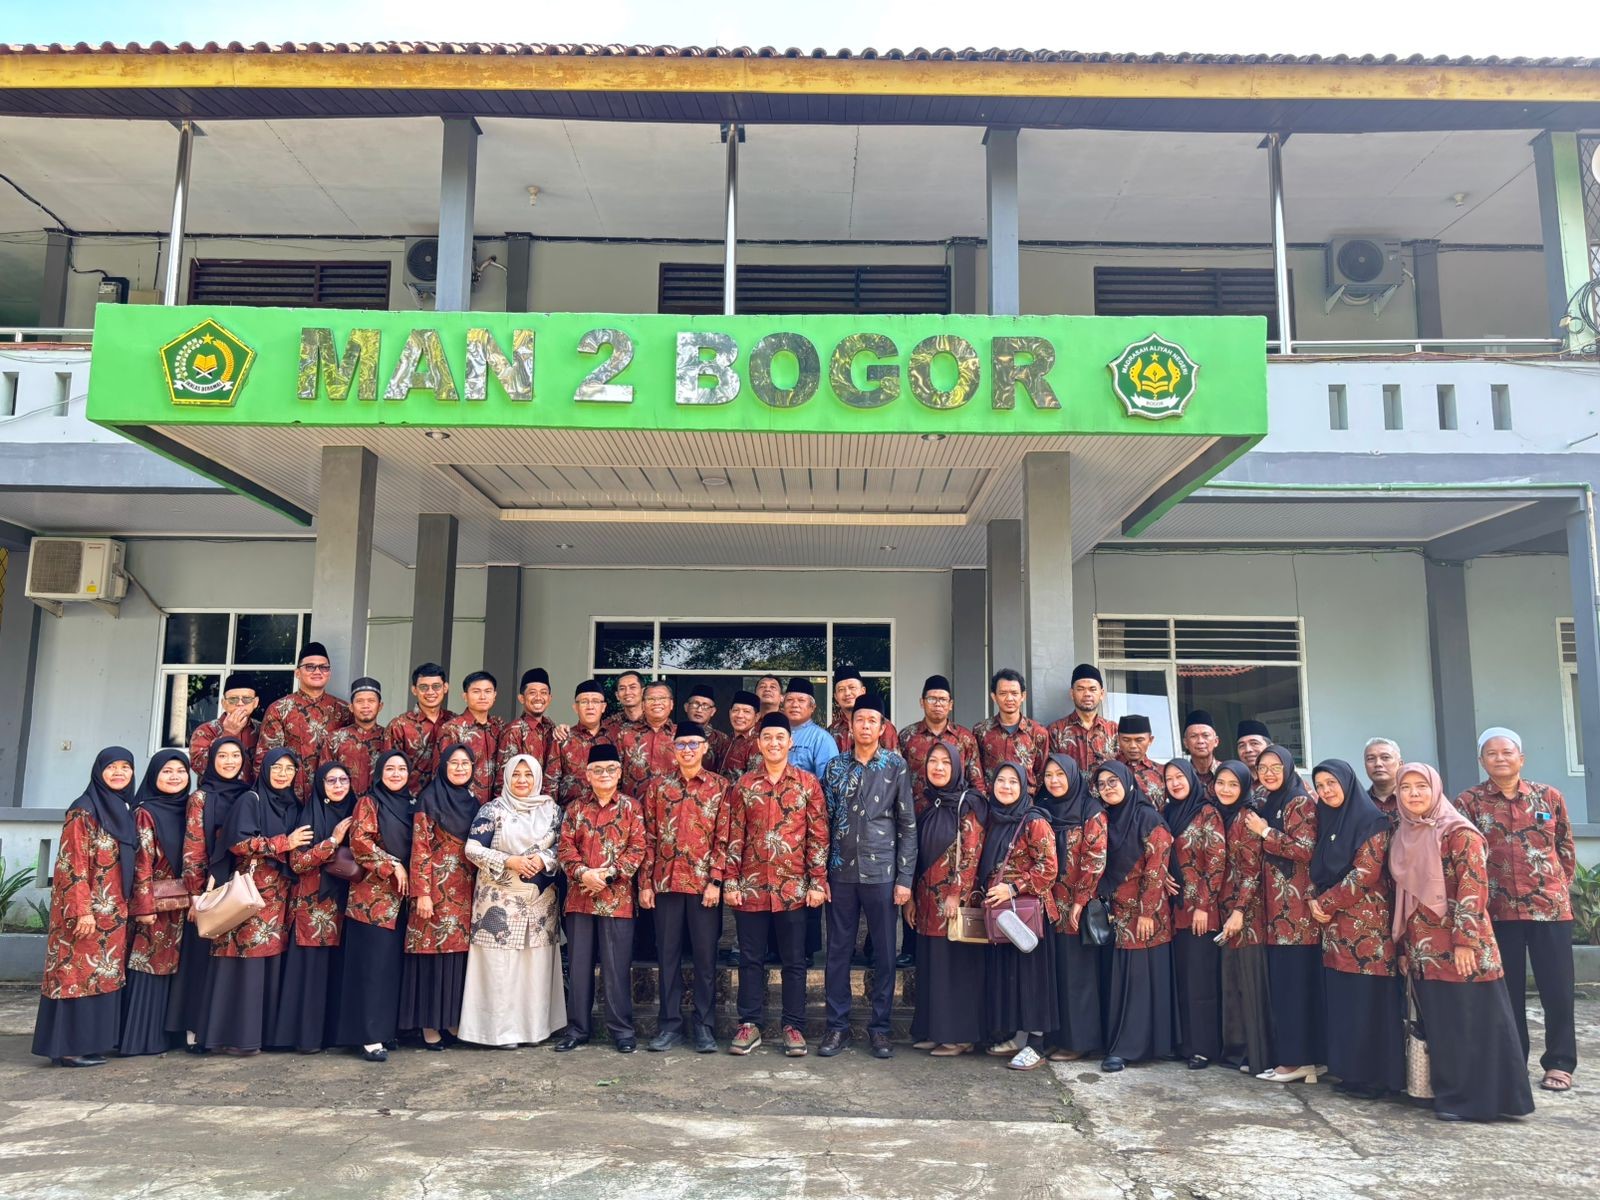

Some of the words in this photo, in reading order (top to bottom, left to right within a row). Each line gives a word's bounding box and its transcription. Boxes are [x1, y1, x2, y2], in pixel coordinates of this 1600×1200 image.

[298, 327, 536, 402] MAN
[573, 328, 635, 404] 2
[675, 331, 1063, 411] BOGOR
[1121, 346, 1148, 374] MADRASAH
[1149, 345, 1173, 355] ALIYAH
[1172, 353, 1188, 375] NEGERI
